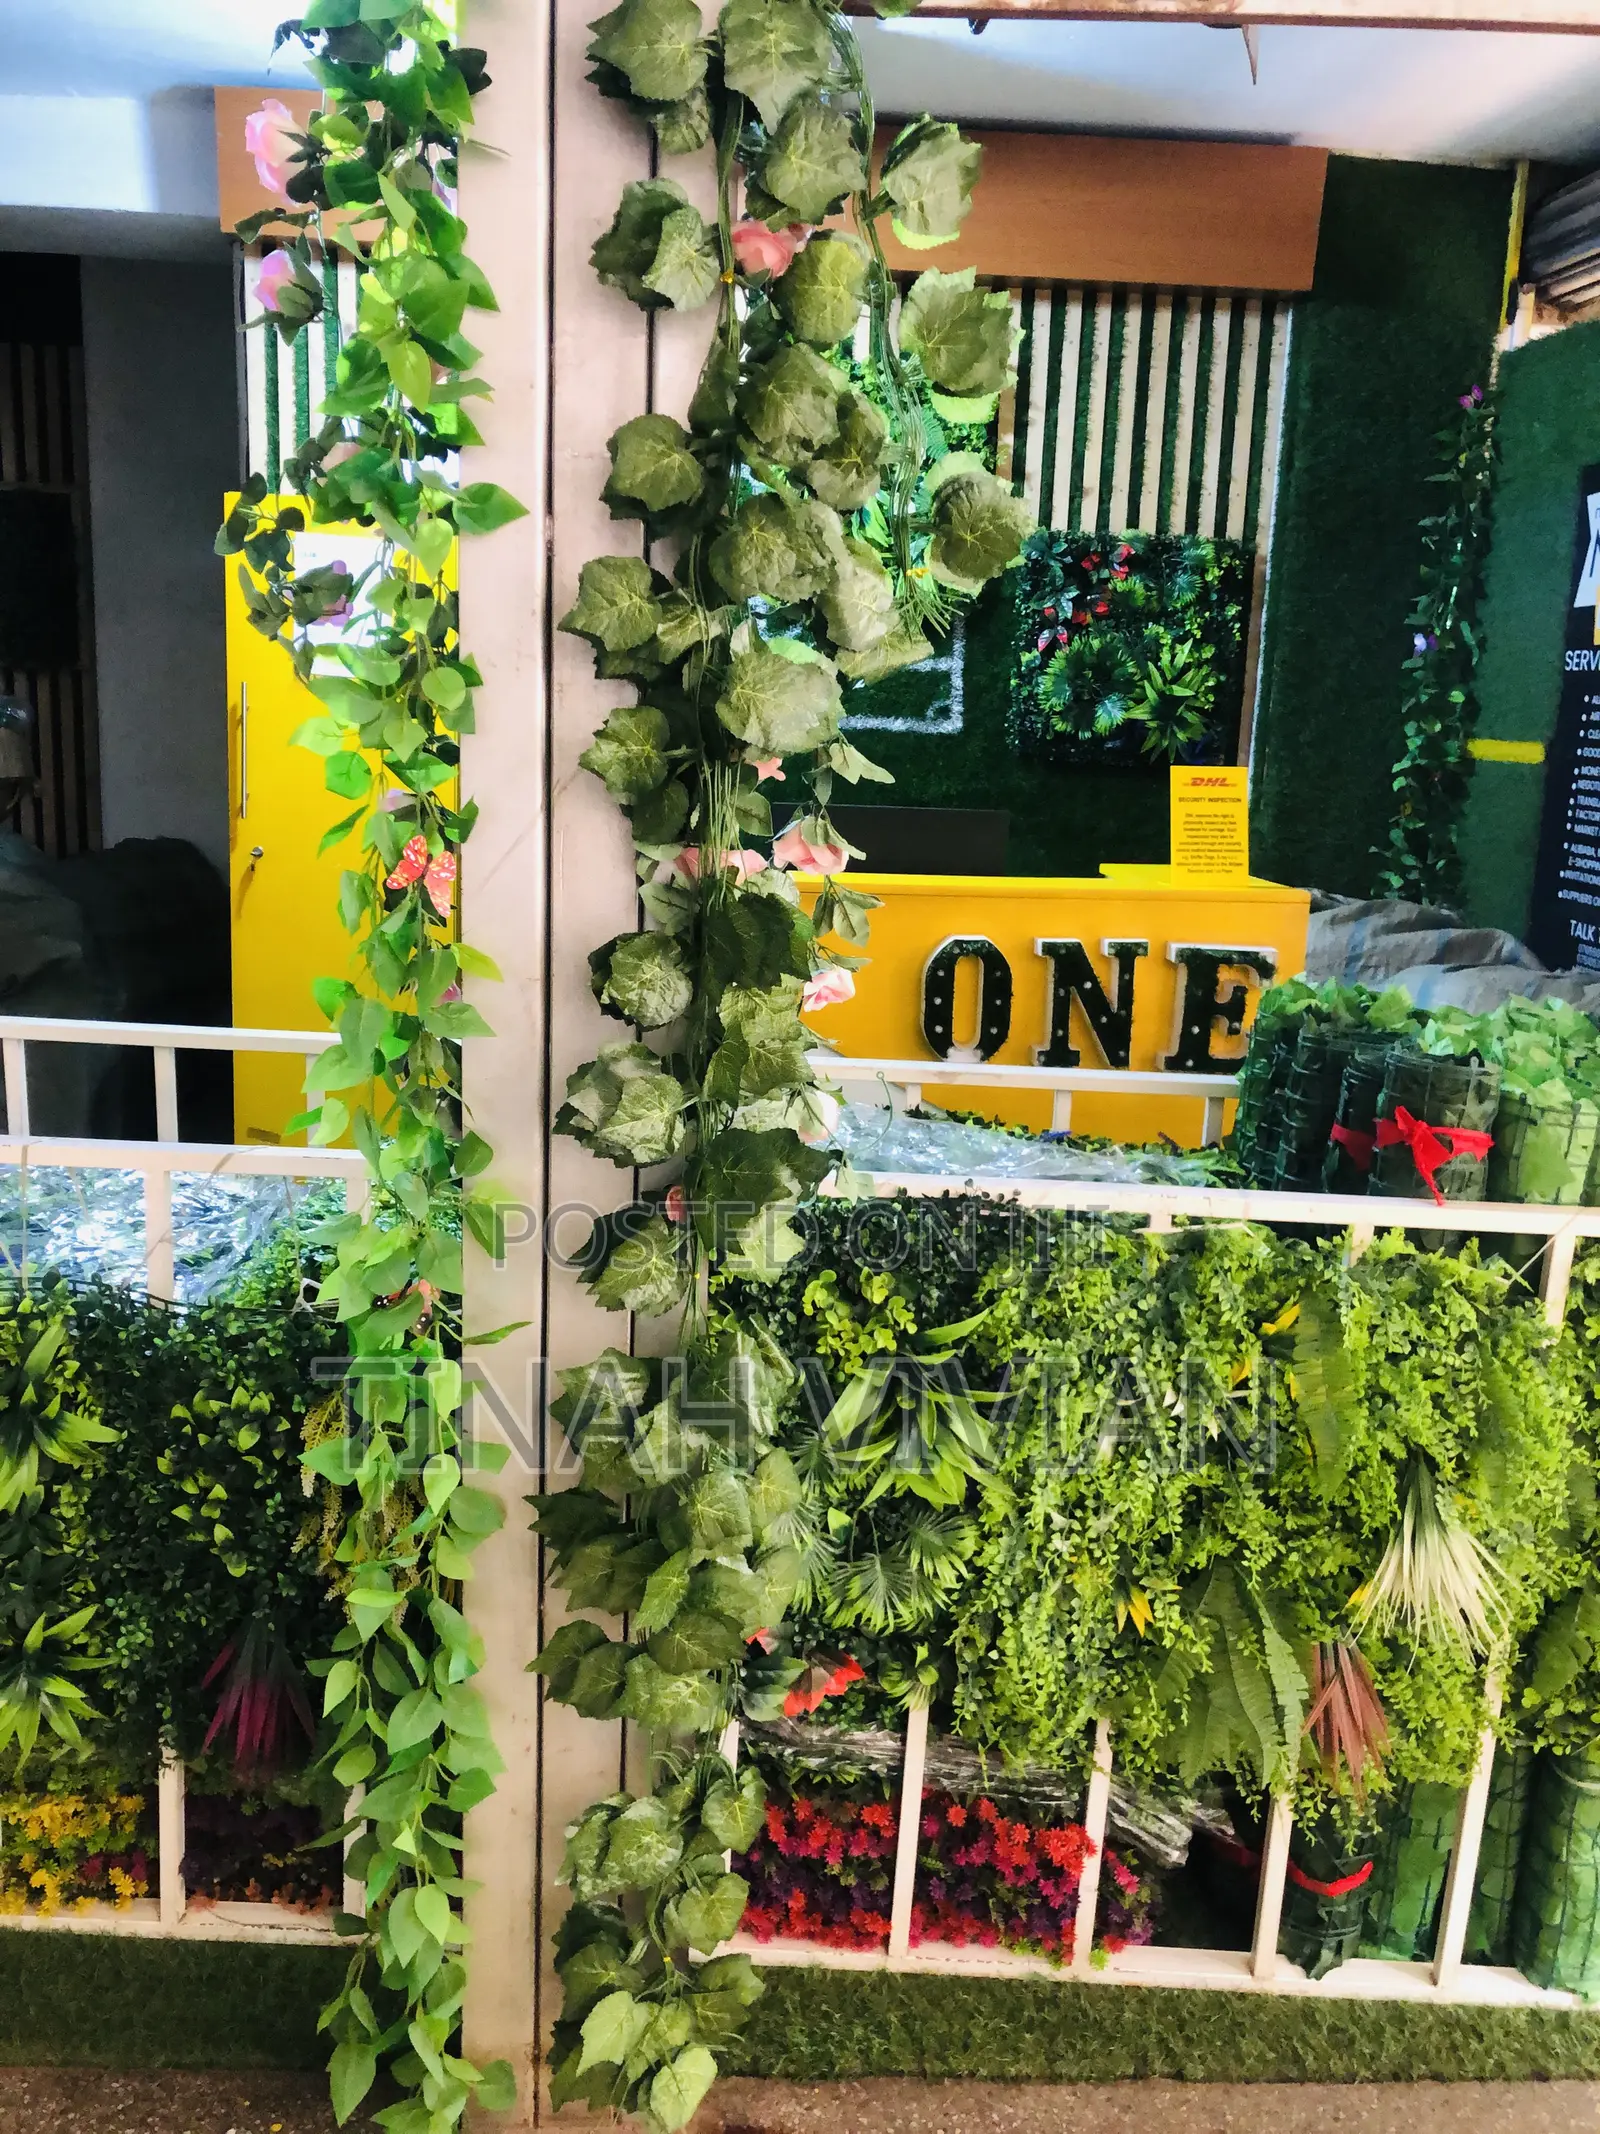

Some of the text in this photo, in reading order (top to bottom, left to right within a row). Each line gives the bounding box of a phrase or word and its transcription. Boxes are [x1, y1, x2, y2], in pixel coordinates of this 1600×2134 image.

[1191, 777, 1230, 787] DHL
[1570, 919, 1596, 942] TALK
[920, 934, 1278, 1074] ONE
